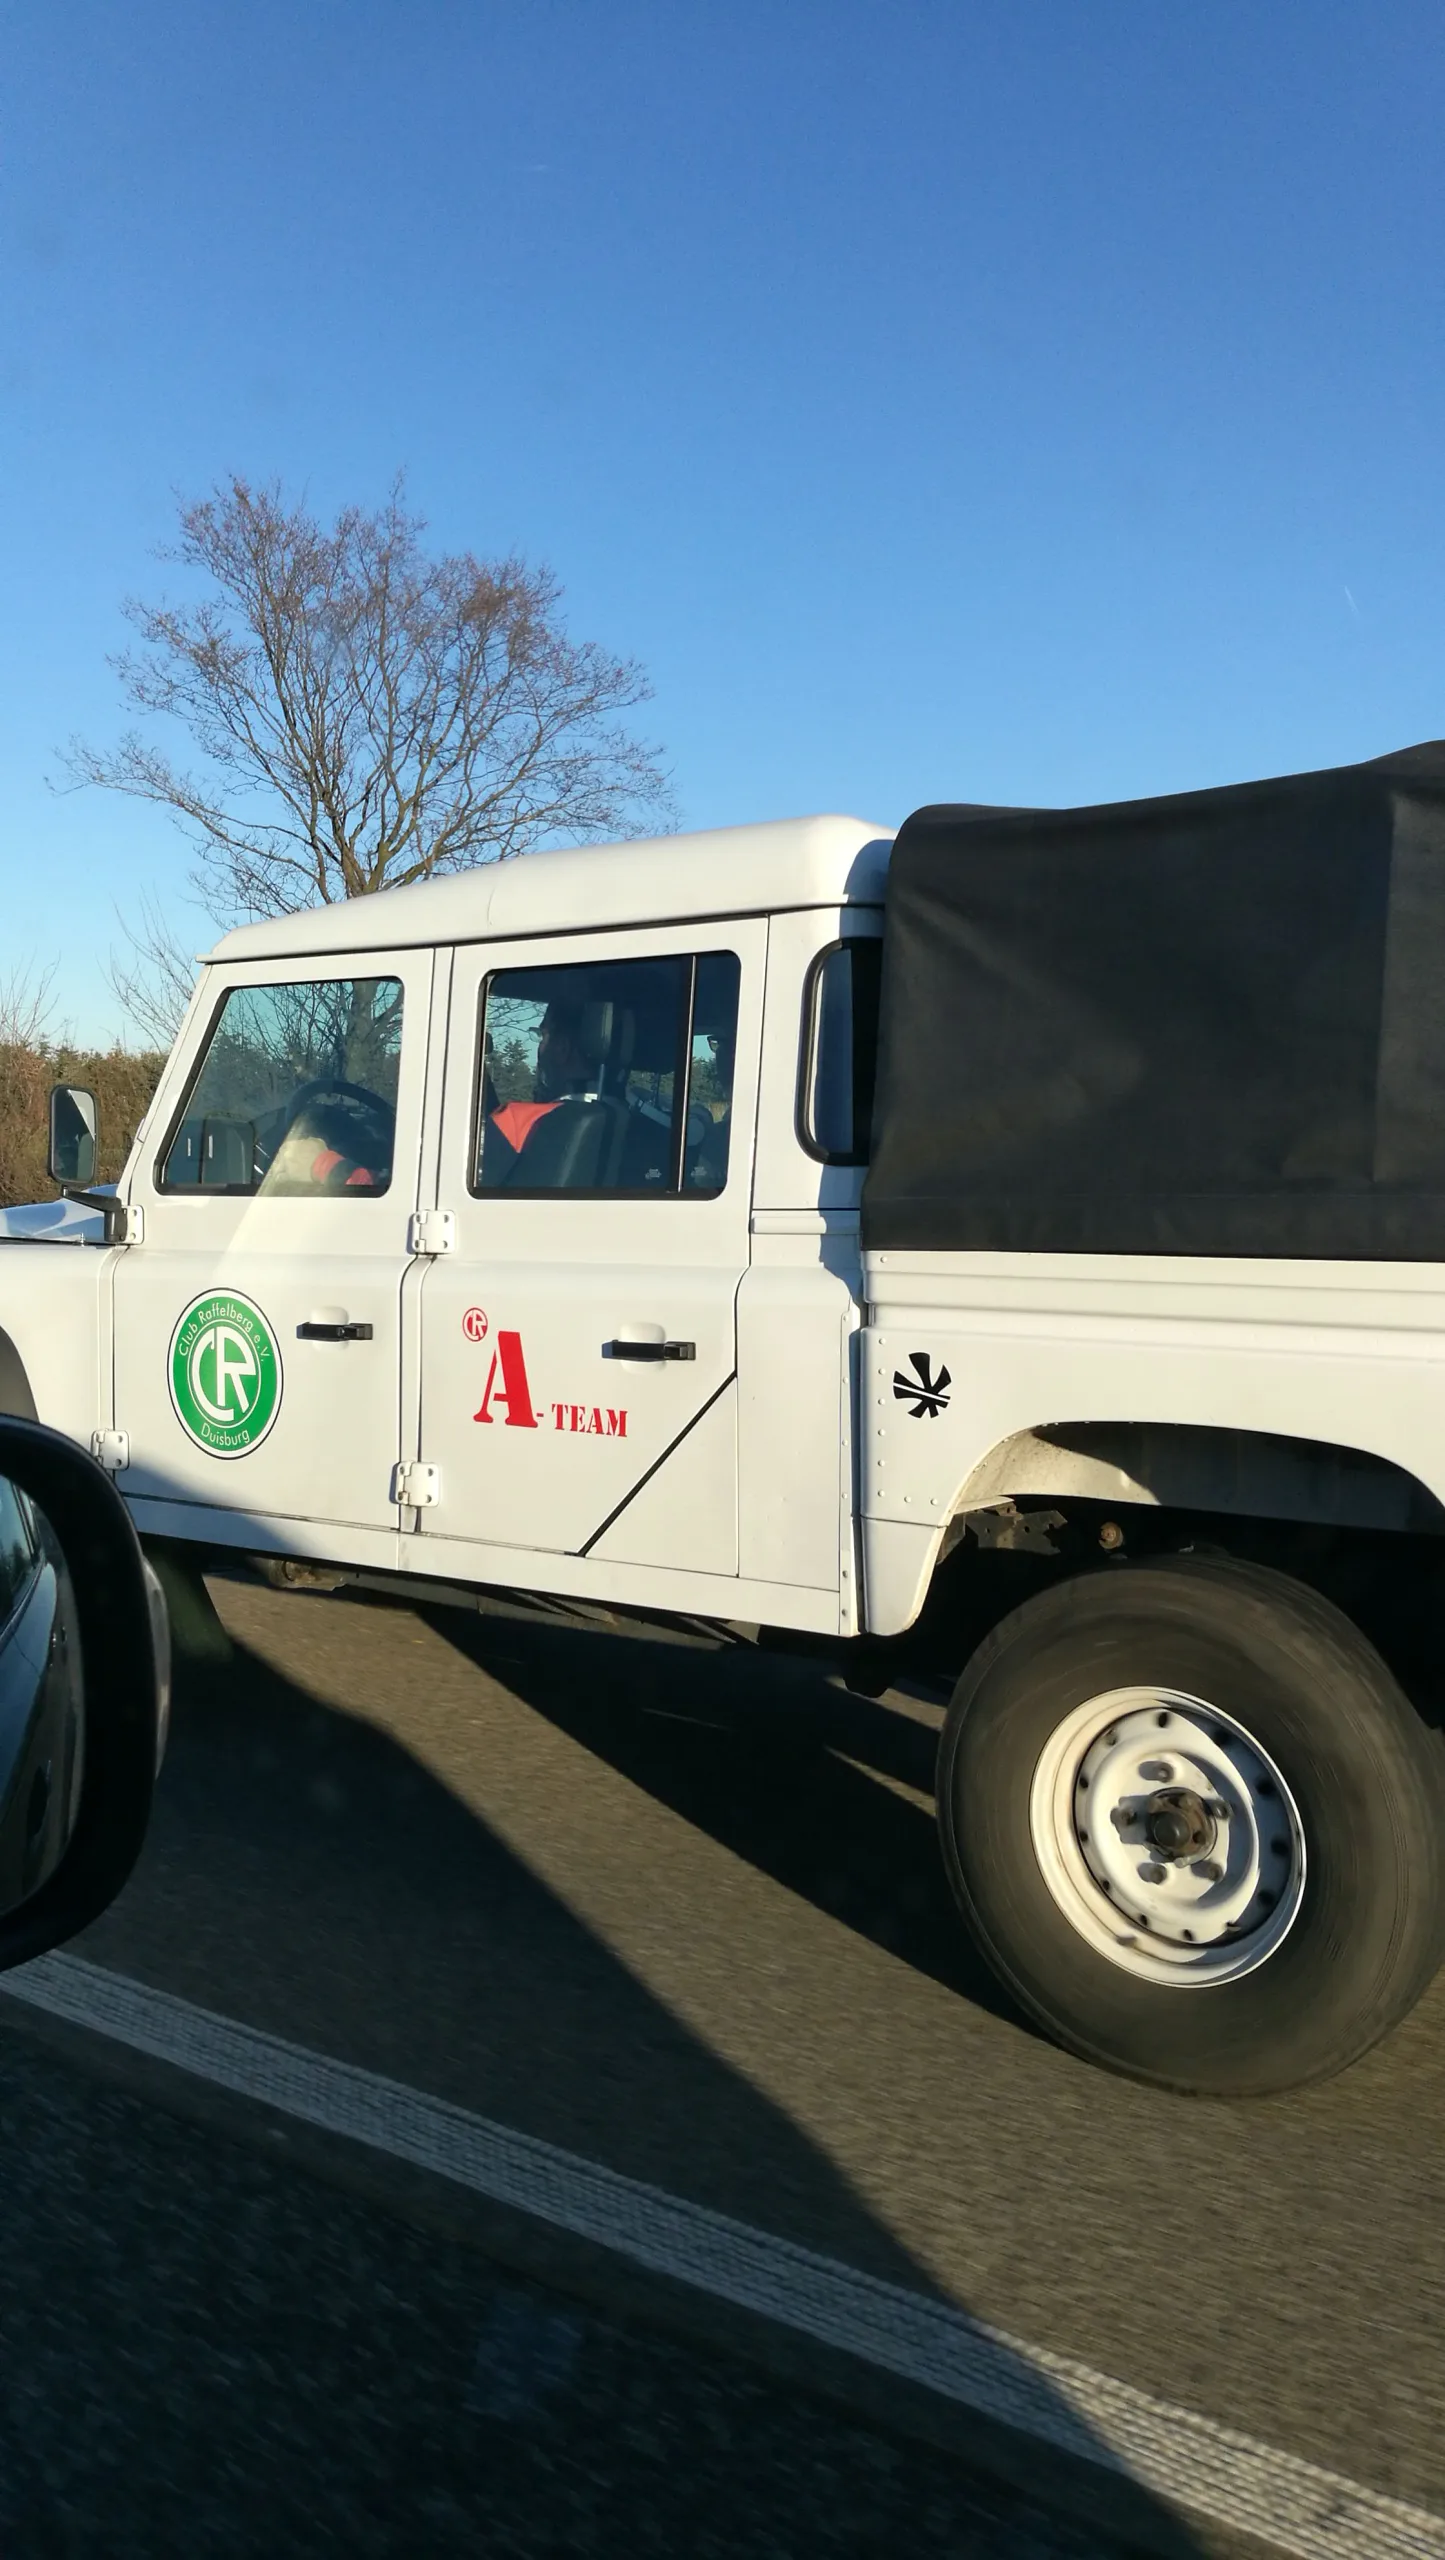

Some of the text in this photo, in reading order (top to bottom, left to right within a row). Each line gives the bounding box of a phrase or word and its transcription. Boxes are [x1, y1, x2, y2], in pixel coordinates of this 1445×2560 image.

[178, 1302, 271, 1362] Club Raffelberg e.V.
[201, 1422, 250, 1447] Duisburg
